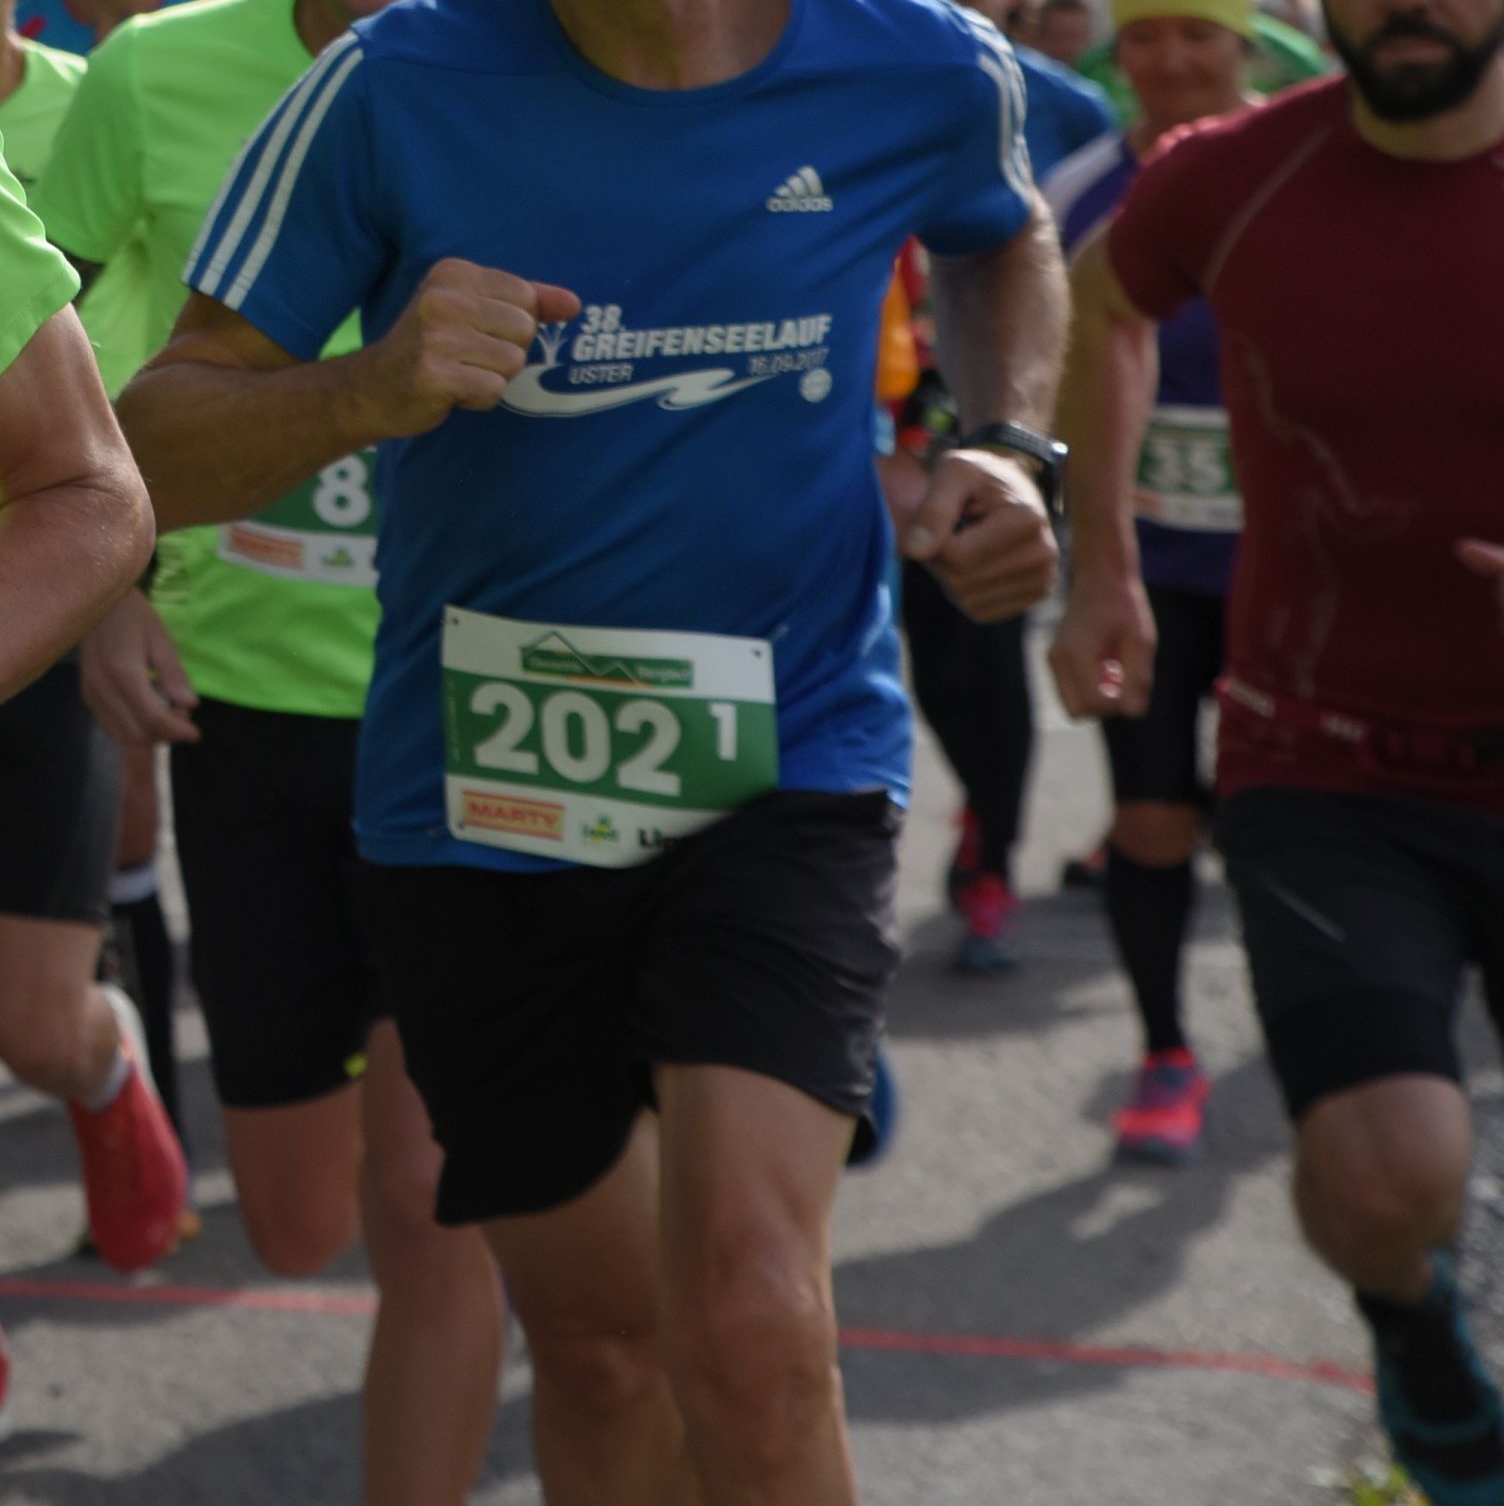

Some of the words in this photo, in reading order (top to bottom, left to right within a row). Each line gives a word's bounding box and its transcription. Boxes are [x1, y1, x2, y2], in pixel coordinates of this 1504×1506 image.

[765, 196, 834, 213] adidas
[581, 304, 626, 335] 38.
[571, 314, 833, 362] GREIFENSEELAUF
[569, 362, 634, 384] USTER
